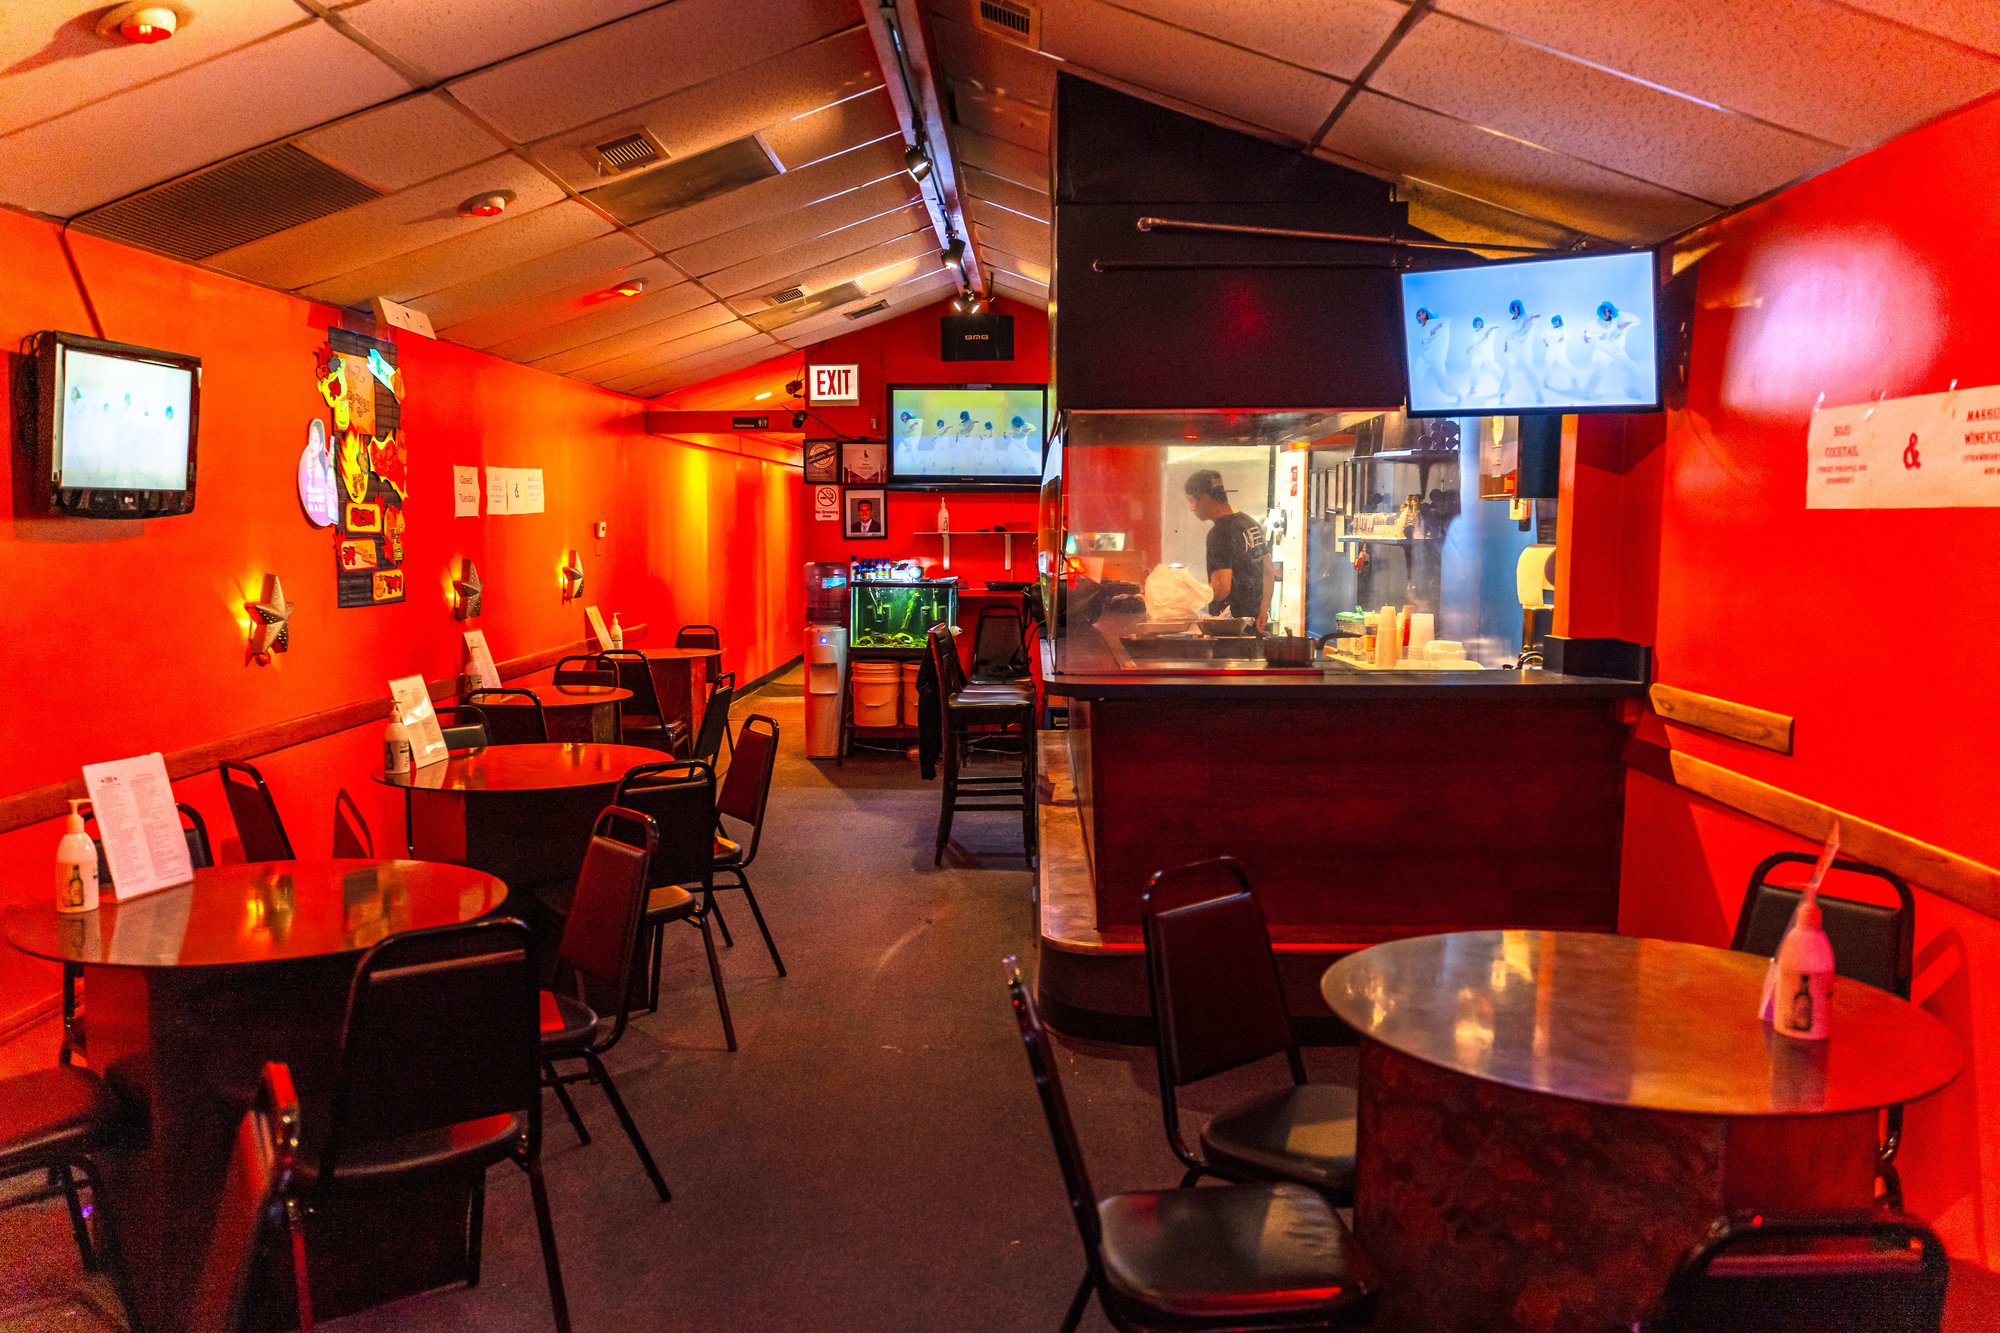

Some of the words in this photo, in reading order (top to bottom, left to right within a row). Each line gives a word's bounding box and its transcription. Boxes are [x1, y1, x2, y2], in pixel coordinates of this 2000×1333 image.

[817, 369, 851, 396] EXIT
[1824, 445, 1860, 458] COCKTAIL
[1903, 432, 1921, 470] &
